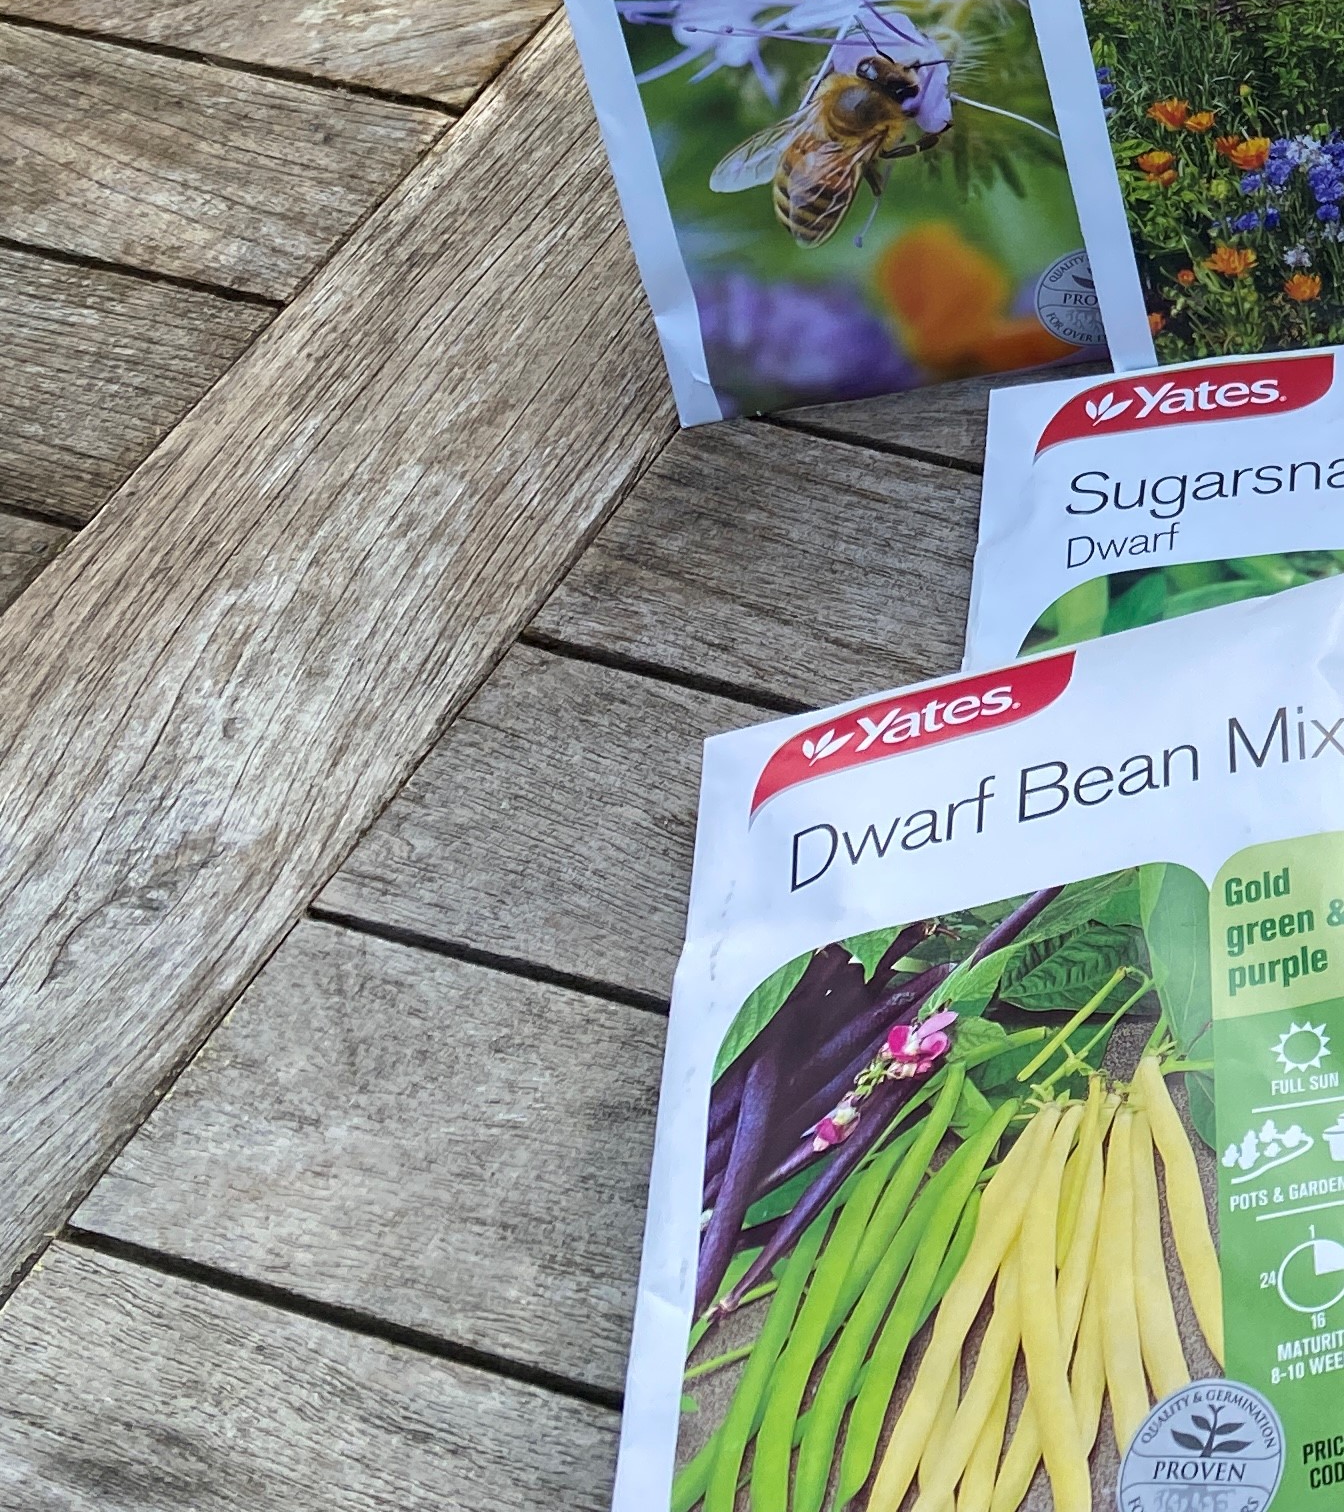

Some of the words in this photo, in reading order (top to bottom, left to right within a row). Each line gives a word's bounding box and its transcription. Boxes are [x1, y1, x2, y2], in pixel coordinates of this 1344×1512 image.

[1134, 379, 1280, 420] Yates
[1067, 523, 1181, 570] Dwarf
[853, 684, 1013, 753] Yates
[790, 775, 996, 893] Dwarf
[1017, 741, 1200, 823] Bean
[1224, 866, 1291, 908] Gold
[1226, 909, 1315, 958] green
[1227, 944, 1329, 997] purple
